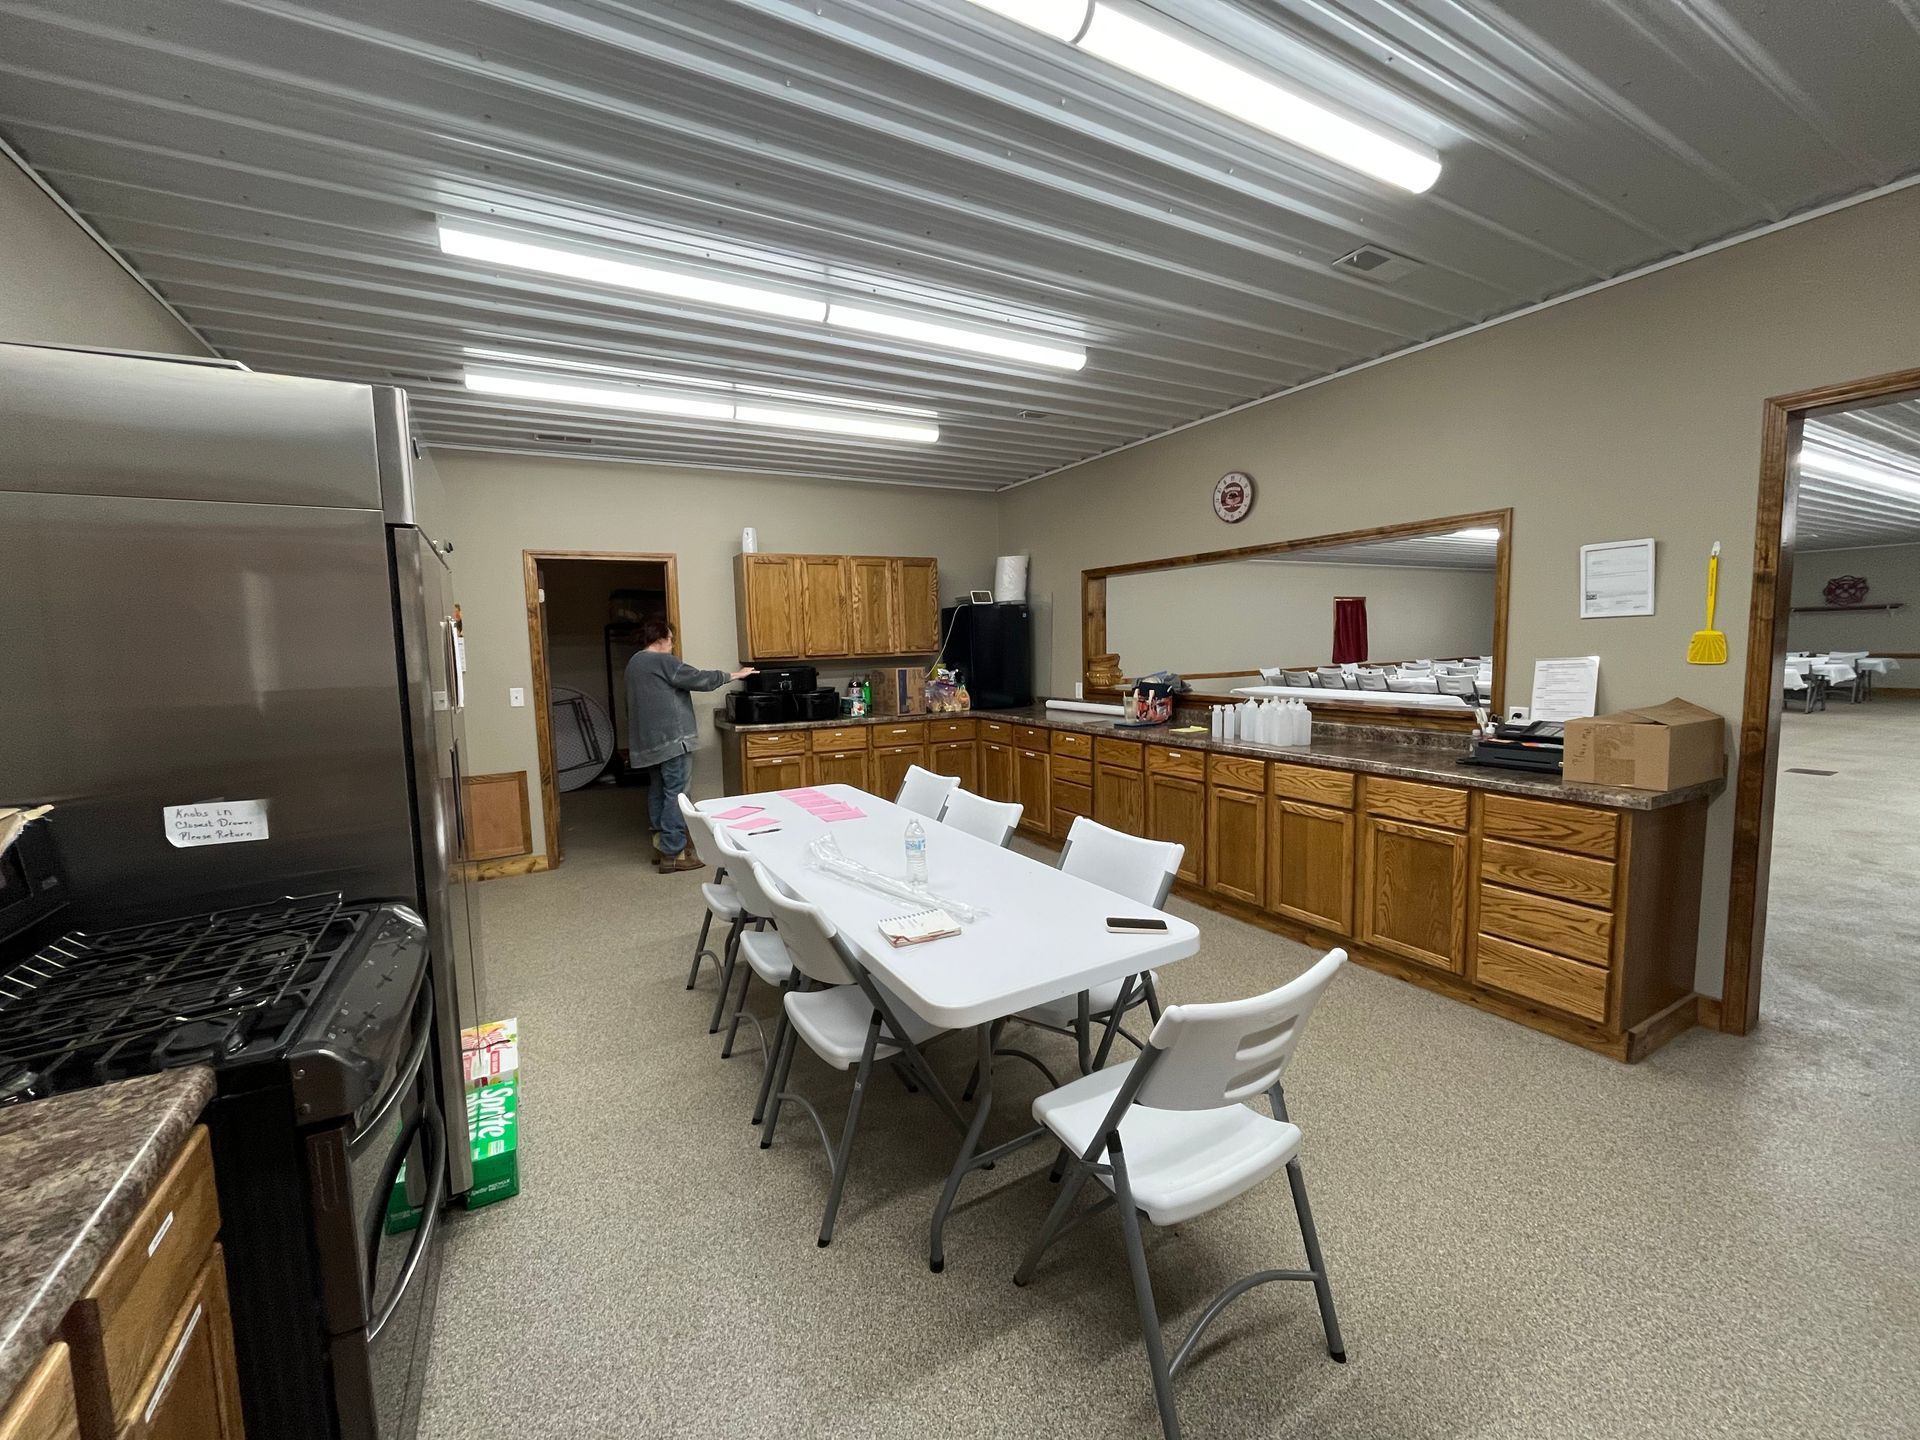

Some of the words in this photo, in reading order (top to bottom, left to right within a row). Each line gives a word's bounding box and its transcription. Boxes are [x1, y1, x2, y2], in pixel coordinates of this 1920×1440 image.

[175, 807, 208, 818] Knobs
[175, 820, 214, 829] Closest
[178, 831, 212, 840] Please
[215, 829, 252, 838] Return
[477, 1087, 515, 1139] Sprite
